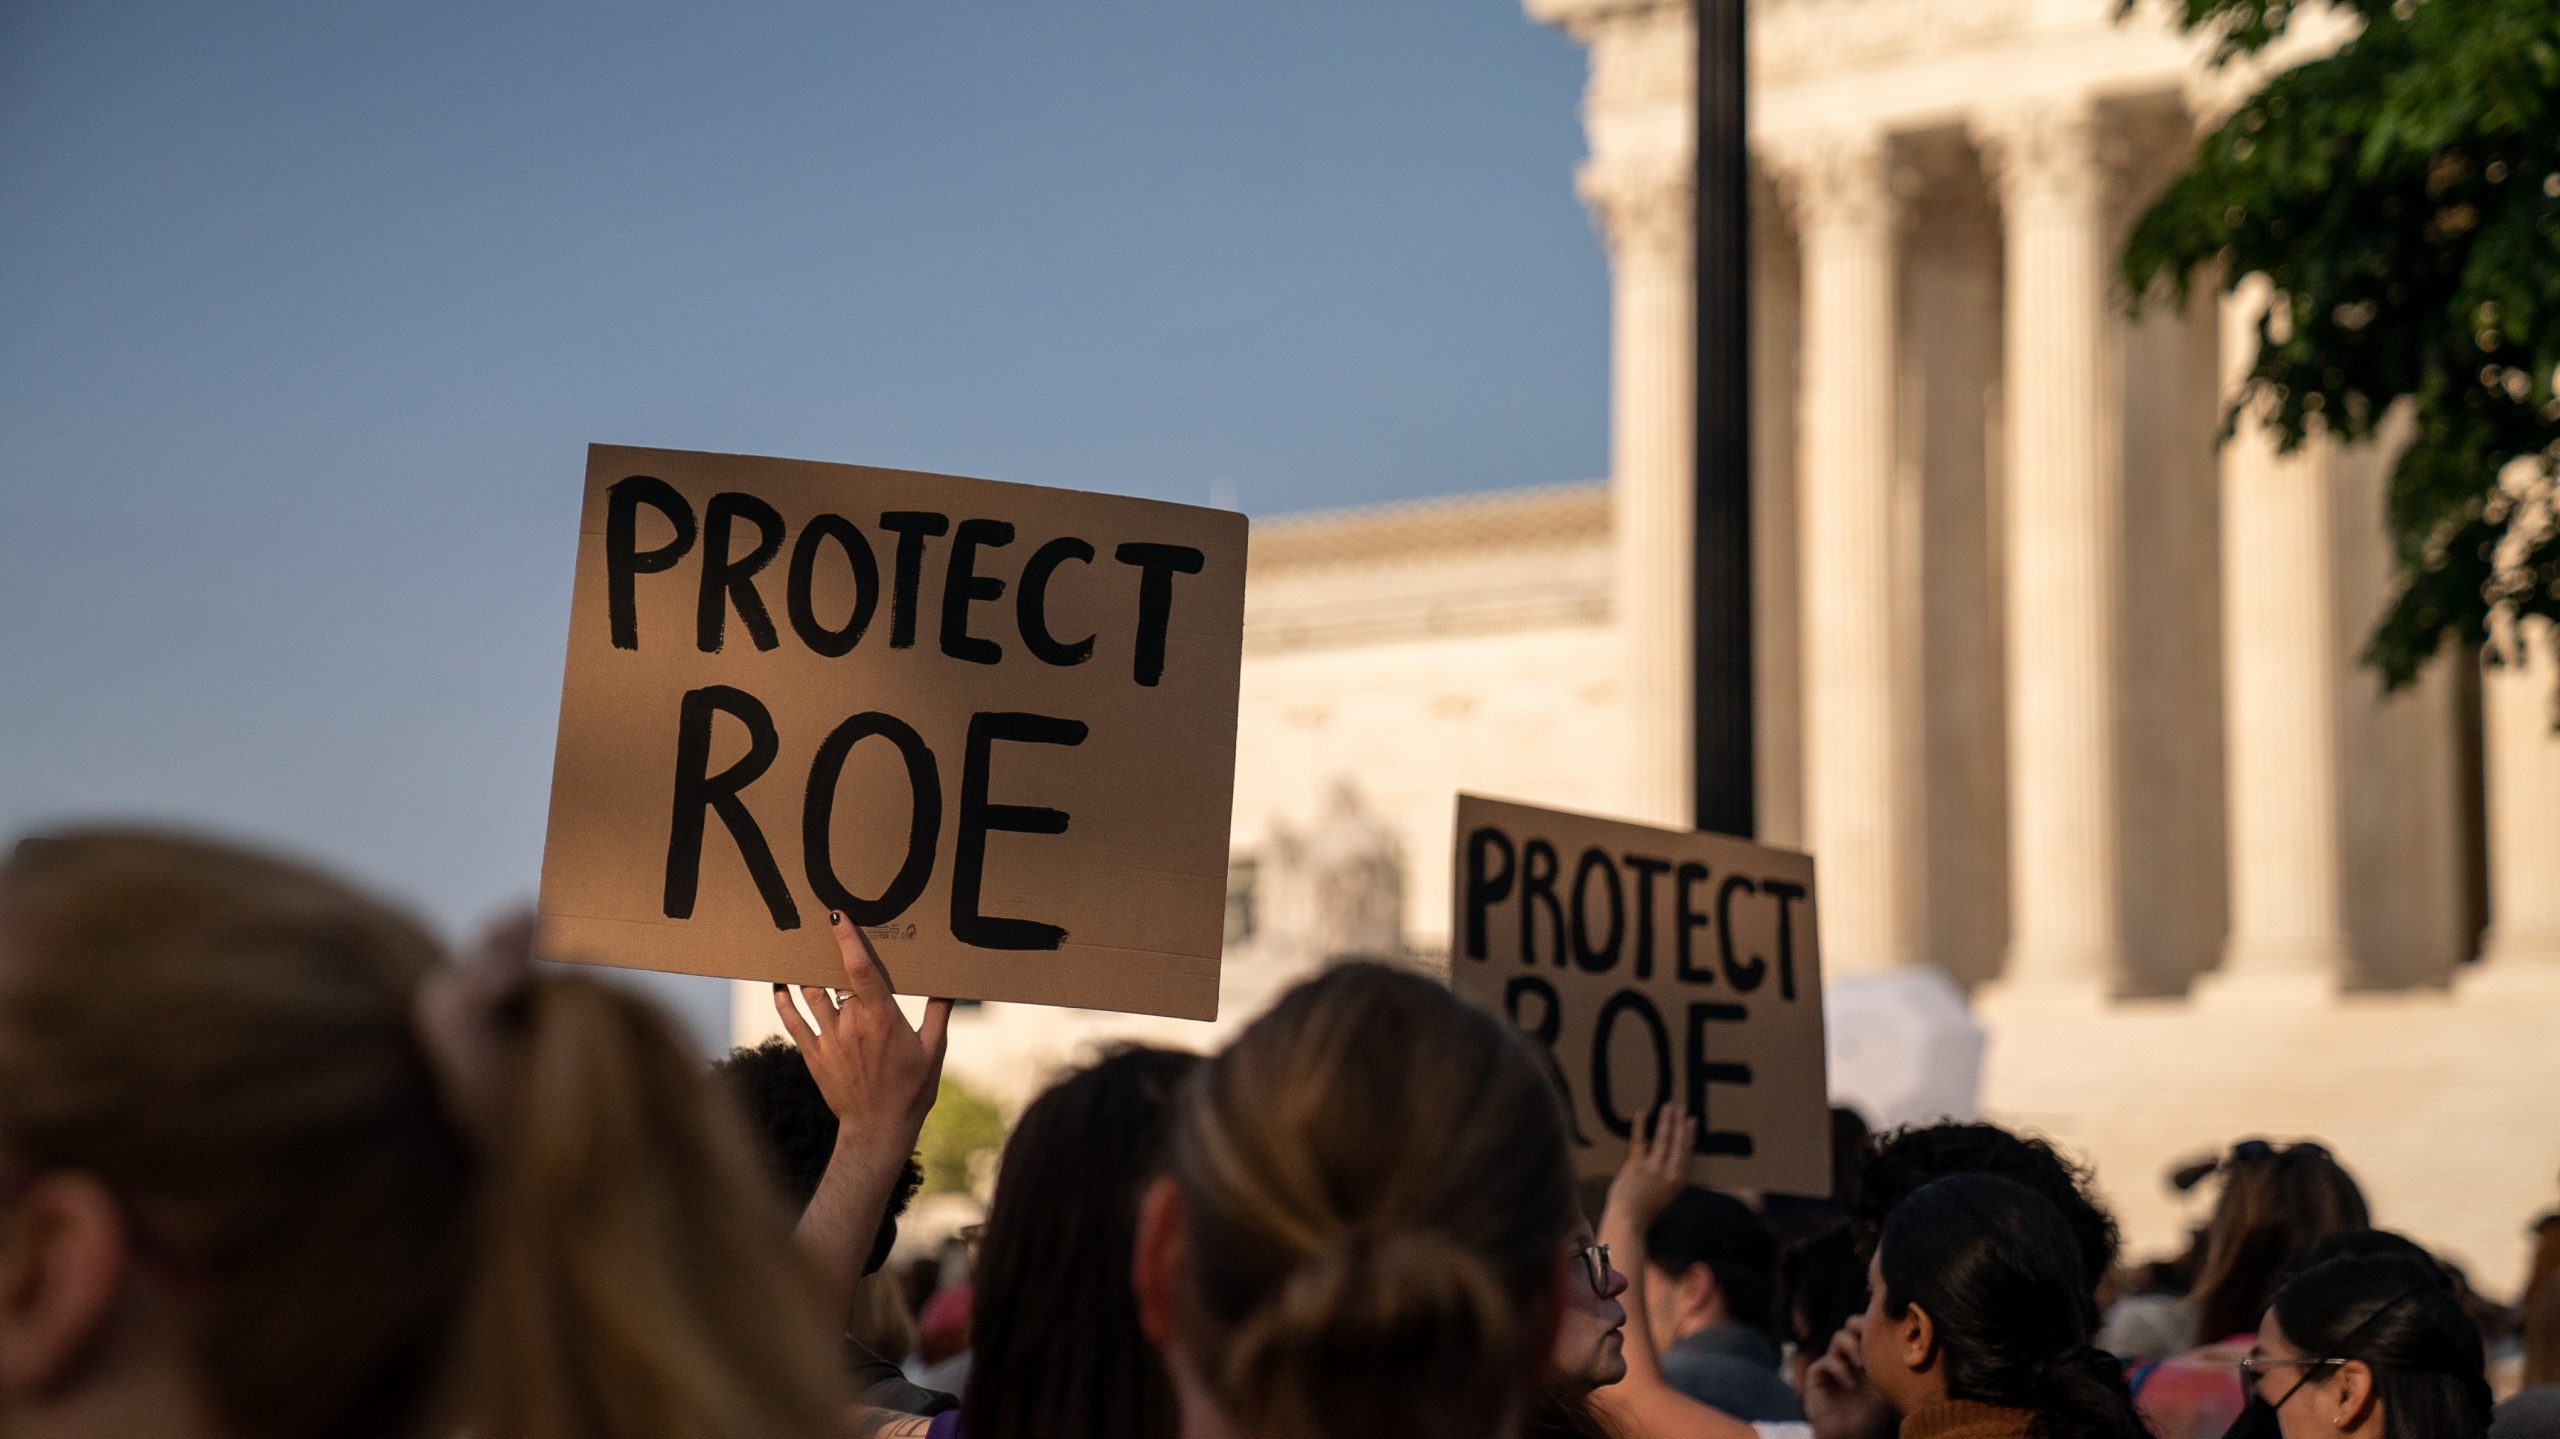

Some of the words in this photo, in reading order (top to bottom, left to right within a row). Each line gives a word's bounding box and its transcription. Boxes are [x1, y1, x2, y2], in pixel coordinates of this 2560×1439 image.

[606, 475, 1205, 686] PROTECT
[663, 685, 1089, 950] ROE
[1466, 827, 1806, 1000] PROTECT
